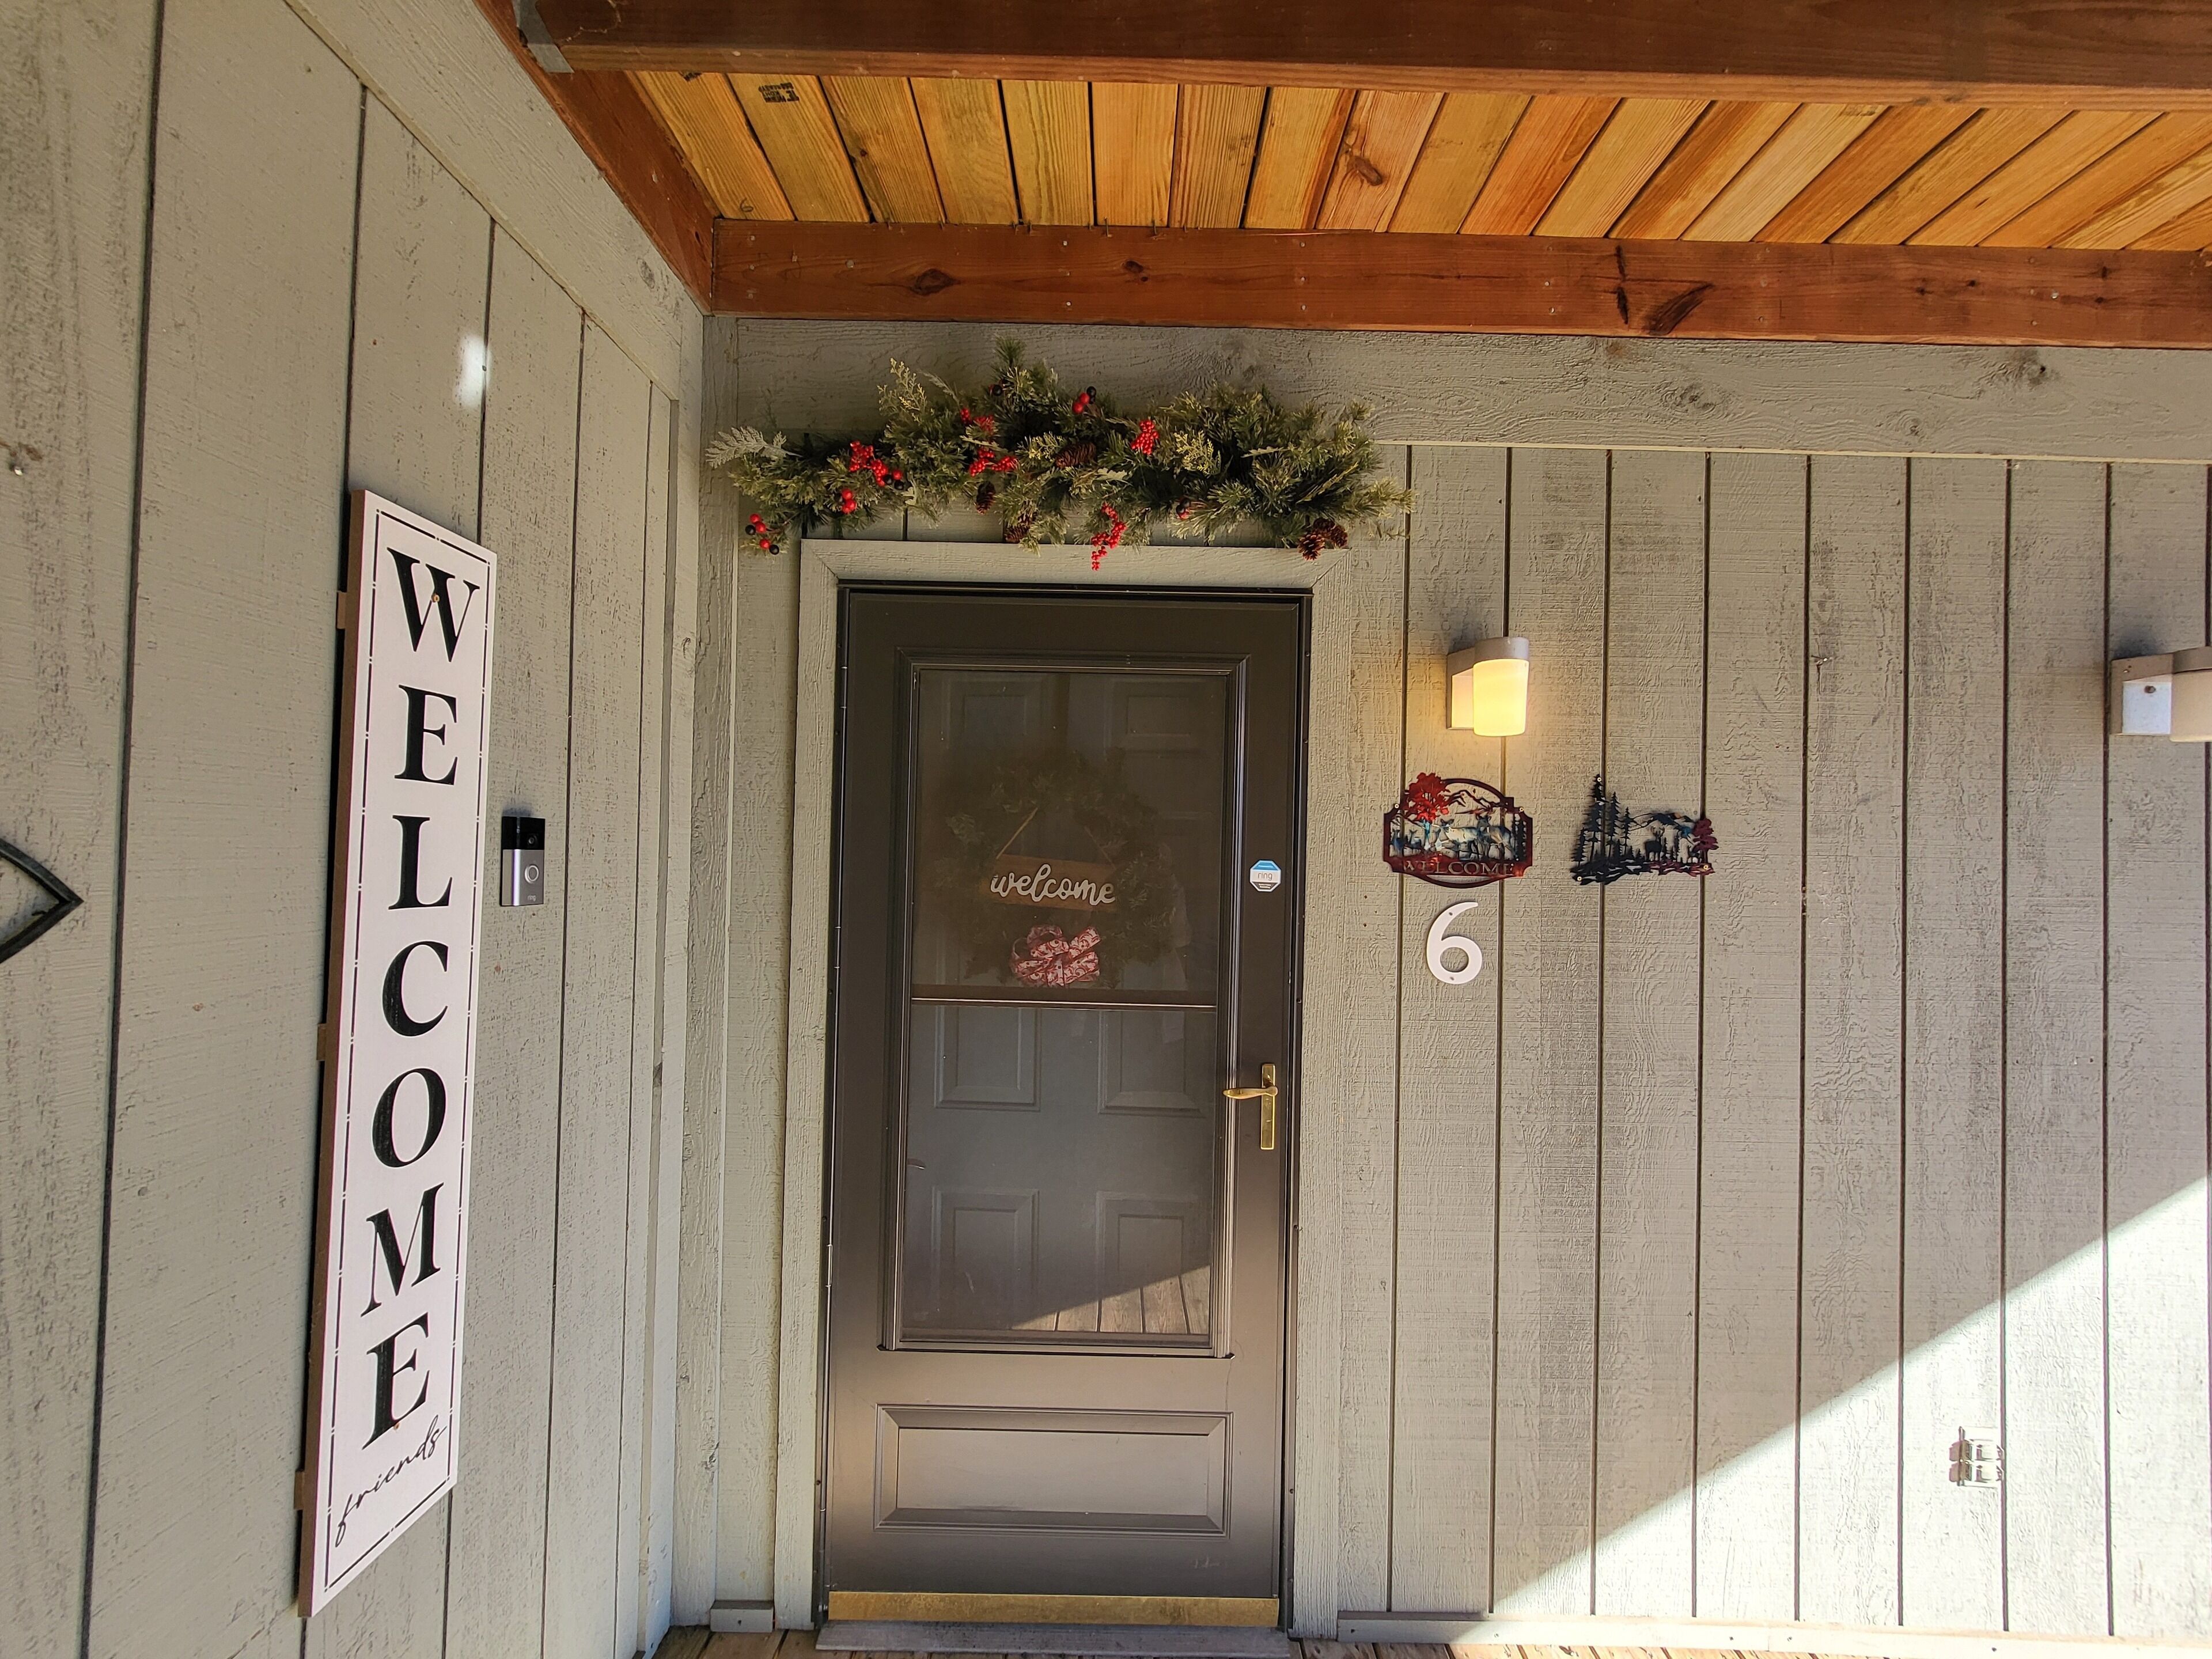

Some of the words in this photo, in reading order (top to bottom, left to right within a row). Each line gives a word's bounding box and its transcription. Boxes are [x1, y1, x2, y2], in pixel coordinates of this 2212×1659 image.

[991, 864, 1116, 906] welcome
[1257, 873, 1272, 881] ring
[1403, 860, 1514, 876] WELCOME
[1426, 902, 1482, 984] 6
[361, 547, 480, 1450] WELCOME
[335, 1415, 448, 1548] friends
